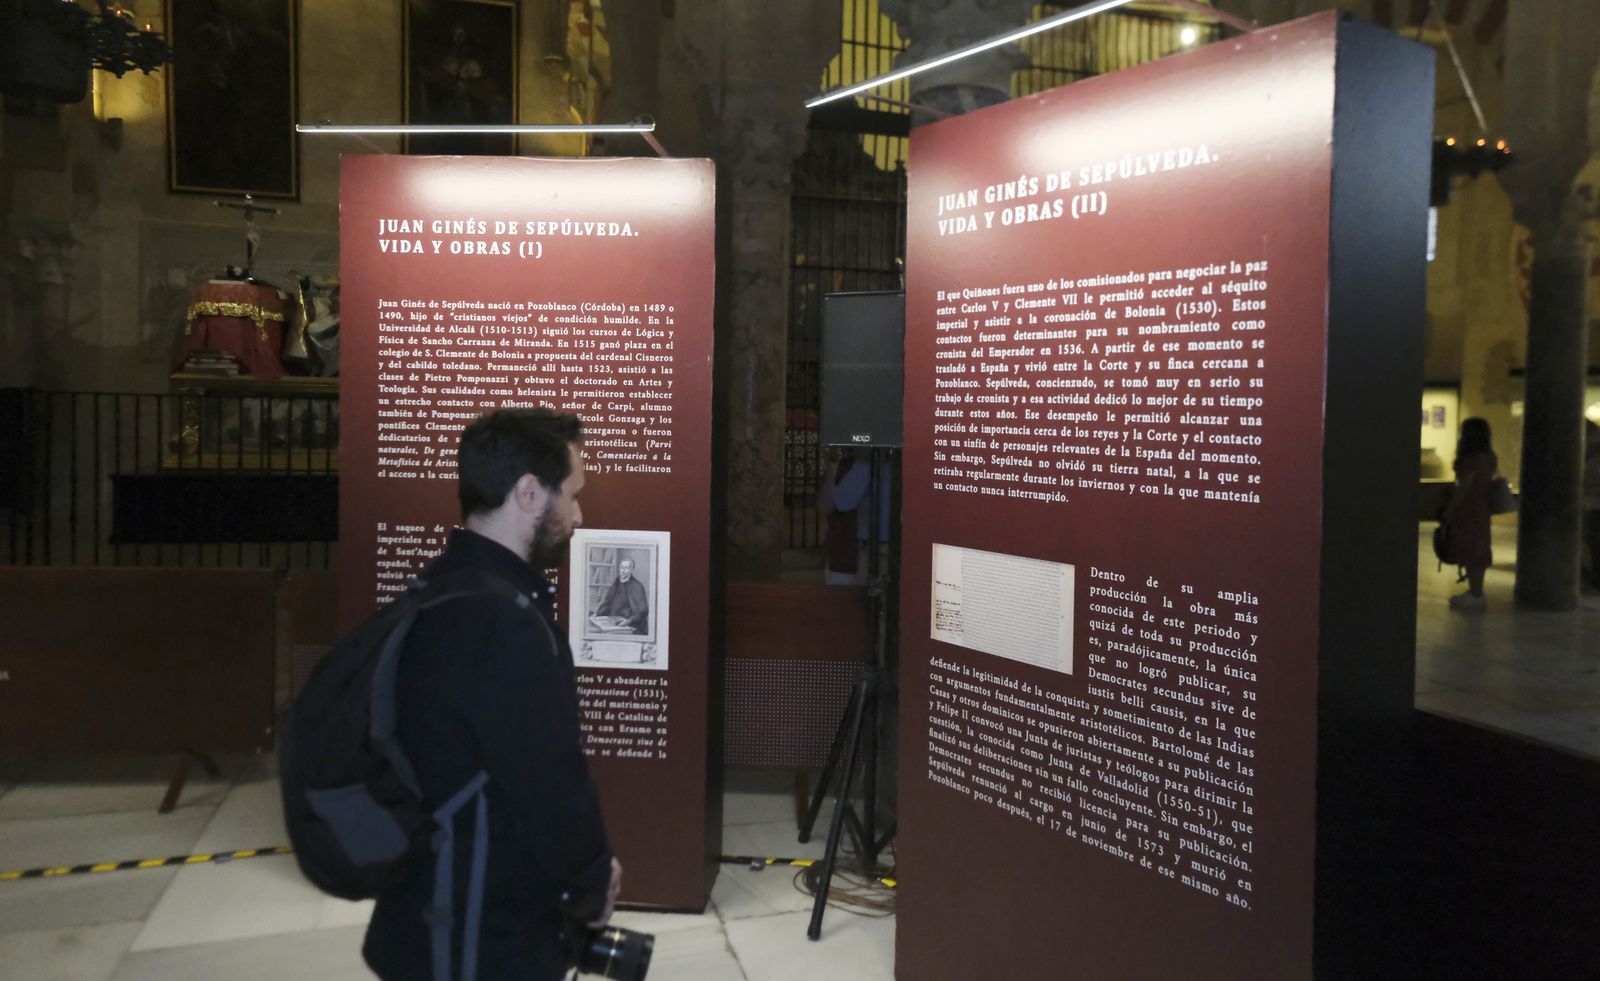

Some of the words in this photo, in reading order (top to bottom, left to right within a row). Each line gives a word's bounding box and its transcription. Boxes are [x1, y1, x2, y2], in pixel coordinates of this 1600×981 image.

[938, 190, 977, 214] JUAN
[984, 175, 1039, 203] GINÉS
[1046, 172, 1072, 193] DE
[1079, 144, 1219, 188] SEPÚLVEDA.
[938, 214, 977, 235] VIDA
[984, 211, 995, 228] Y
[1001, 198, 1063, 225] OBRAS
[1071, 191, 1107, 219] (II)
[378, 218, 423, 235] JUAN
[432, 217, 486, 234] GINÉS
[494, 221, 517, 234] DE
[526, 218, 638, 236] SEPÚLVEDA.
[378, 239, 424, 253] VIDA
[431, 240, 442, 253] Y
[450, 240, 510, 254] OBRAS
[519, 241, 542, 258] (I)
[377, 298, 398, 309] Juan
[400, 299, 425, 308] Ginés
[428, 299, 438, 308] de
[441, 300, 484, 310] Sepúlveda
[487, 301, 511, 309] nació
[527, 301, 576, 310] Pozoblanco
[580, 302, 625, 313] (Córdoba)
[644, 303, 665, 312] 1489
[936, 318, 967, 332] imperial
[973, 320, 979, 330] y
[984, 315, 1011, 326] asistir
[1029, 313, 1037, 324] la
[1044, 309, 1096, 322] coronación
[1104, 307, 1116, 319] de
[1124, 304, 1165, 318] Bolonia
[1175, 299, 1221, 319] (1530).
[1232, 298, 1266, 311] Estos
[380, 311, 404, 320] 1490,
[410, 311, 427, 322] hijo
[433, 312, 443, 320] de
[538, 314, 548, 322] de
[554, 314, 597, 323] condición
[603, 315, 641, 324] humilde.
[648, 315, 659, 324] En
[666, 316, 673, 324] la
[378, 323, 430, 332] Universidad
[434, 324, 444, 332] de
[448, 324, 475, 333] Alcalá
[479, 324, 537, 337] (1510-1513)
[542, 326, 568, 336] siguió
[572, 326, 585, 335] los
[621, 328, 631, 336] de
[636, 328, 664, 338] Lógica
[668, 330, 673, 338] y
[936, 335, 972, 344] contactos
[978, 332, 1006, 342] fueron
[1013, 328, 1077, 340] determinantes
[1085, 328, 1107, 340] para
[1116, 327, 1128, 336] su
[1138, 320, 1220, 335] nombramiento
[1231, 319, 1265, 330] como
[935, 377, 980, 388] Pozoblanco.
[986, 377, 1030, 390] Sepúlveda,
[1035, 376, 1096, 388] concienzudo,
[1103, 379, 1114, 387] se
[1121, 376, 1148, 387] tomó
[1156, 378, 1179, 390] muy
[1187, 378, 1201, 387] en
[1209, 375, 1240, 387] serio
[1249, 378, 1263, 387] su
[378, 421, 419, 430] pontífices
[425, 421, 465, 430] Clemente
[934, 407, 963, 417] durante
[969, 409, 989, 418] estos
[996, 409, 1017, 418] años.
[1024, 408, 1039, 419] Ese
[1046, 409, 1098, 423] desempeño
[1106, 410, 1115, 421] le
[1124, 411, 1170, 425] permitió
[1180, 411, 1229, 425] alcanzar
[1239, 416, 1262, 426] una
[584, 438, 637, 447] aristotélicas
[645, 439, 671, 449] (Parvi
[377, 522, 386, 530] El
[396, 525, 425, 533] saqueo
[433, 524, 444, 532] de
[376, 570, 403, 579] volvió
[1090, 566, 1125, 582] Dentro
[1146, 576, 1158, 588] de
[1180, 584, 1193, 594] su
[1217, 590, 1258, 605] amplia
[1089, 586, 1146, 603] producción
[1162, 596, 1172, 608] la
[1189, 602, 1215, 616] obra
[1234, 611, 1258, 624] más
[1089, 603, 1134, 618] conocida
[1142, 610, 1154, 622] de
[1163, 617, 1184, 628] este
[1194, 623, 1240, 639] periodo
[1250, 634, 1257, 646] y
[1089, 619, 1115, 632] quizá
[1121, 623, 1133, 635] de
[1140, 628, 1163, 642] toda
[1170, 636, 1181, 646] su
[1189, 640, 1256, 662] producción
[1088, 636, 1101, 647] es,
[1107, 640, 1198, 669] paradójicamente,
[1206, 659, 1216, 672] la
[1223, 664, 1256, 681] única
[614, 675, 657, 685] abanderar
[660, 677, 667, 686] la
[1088, 653, 1105, 664] que
[1115, 659, 1128, 669] no
[1138, 661, 1167, 678] logró
[1178, 674, 1229, 695] publicar,
[1242, 690, 1256, 700] su
[1088, 666, 1147, 691] Democrates
[1153, 686, 1204, 706] secundus
[1211, 699, 1234, 714] sive
[1241, 706, 1256, 719] de
[584, 710, 601, 719] VIII
[604, 711, 614, 720] de
[617, 712, 654, 721] Catalina
[656, 713, 667, 722] de
[1088, 683, 1114, 700] iustis
[1120, 691, 1143, 708] belli
[1150, 703, 1186, 721] causis,
[1194, 715, 1207, 726] en
[1215, 717, 1225, 731] la
[1233, 726, 1255, 739] que
[928, 769, 970, 794] Pozoblanco
[974, 790, 992, 803] poco
[996, 797, 1032, 820] después,
[1036, 814, 1044, 825] el
[1050, 819, 1060, 830] 17
[1065, 825, 1076, 838] de
[1082, 834, 1134, 862] noviembre
[1139, 855, 1152, 869] de
[1157, 865, 1174, 878] ese
[1181, 874, 1218, 896] mismo
[1225, 893, 1251, 910] año.
